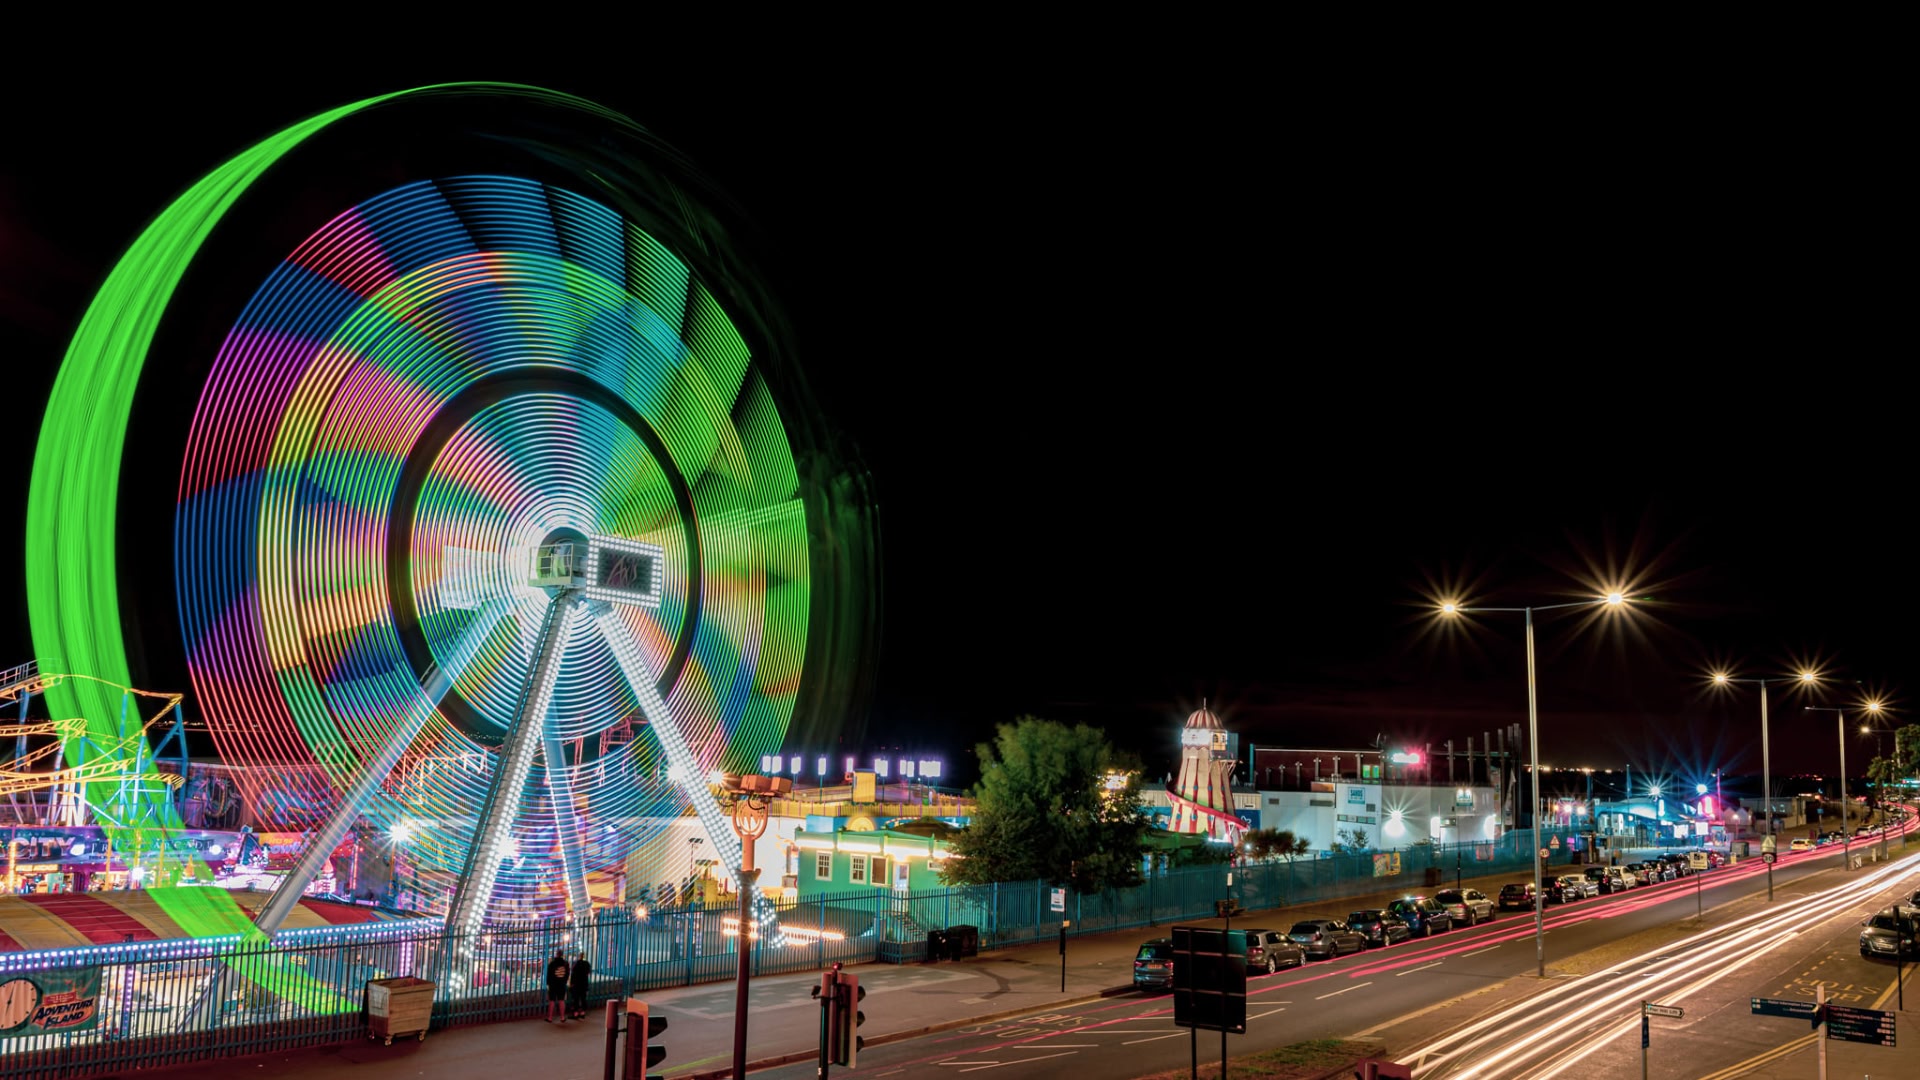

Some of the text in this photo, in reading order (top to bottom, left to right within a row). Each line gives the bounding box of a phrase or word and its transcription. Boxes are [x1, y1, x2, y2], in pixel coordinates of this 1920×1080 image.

[7, 836, 76, 858] CITY
[32, 997, 94, 1023] ADVENTURE
[43, 1011, 84, 1030] ISLAND
